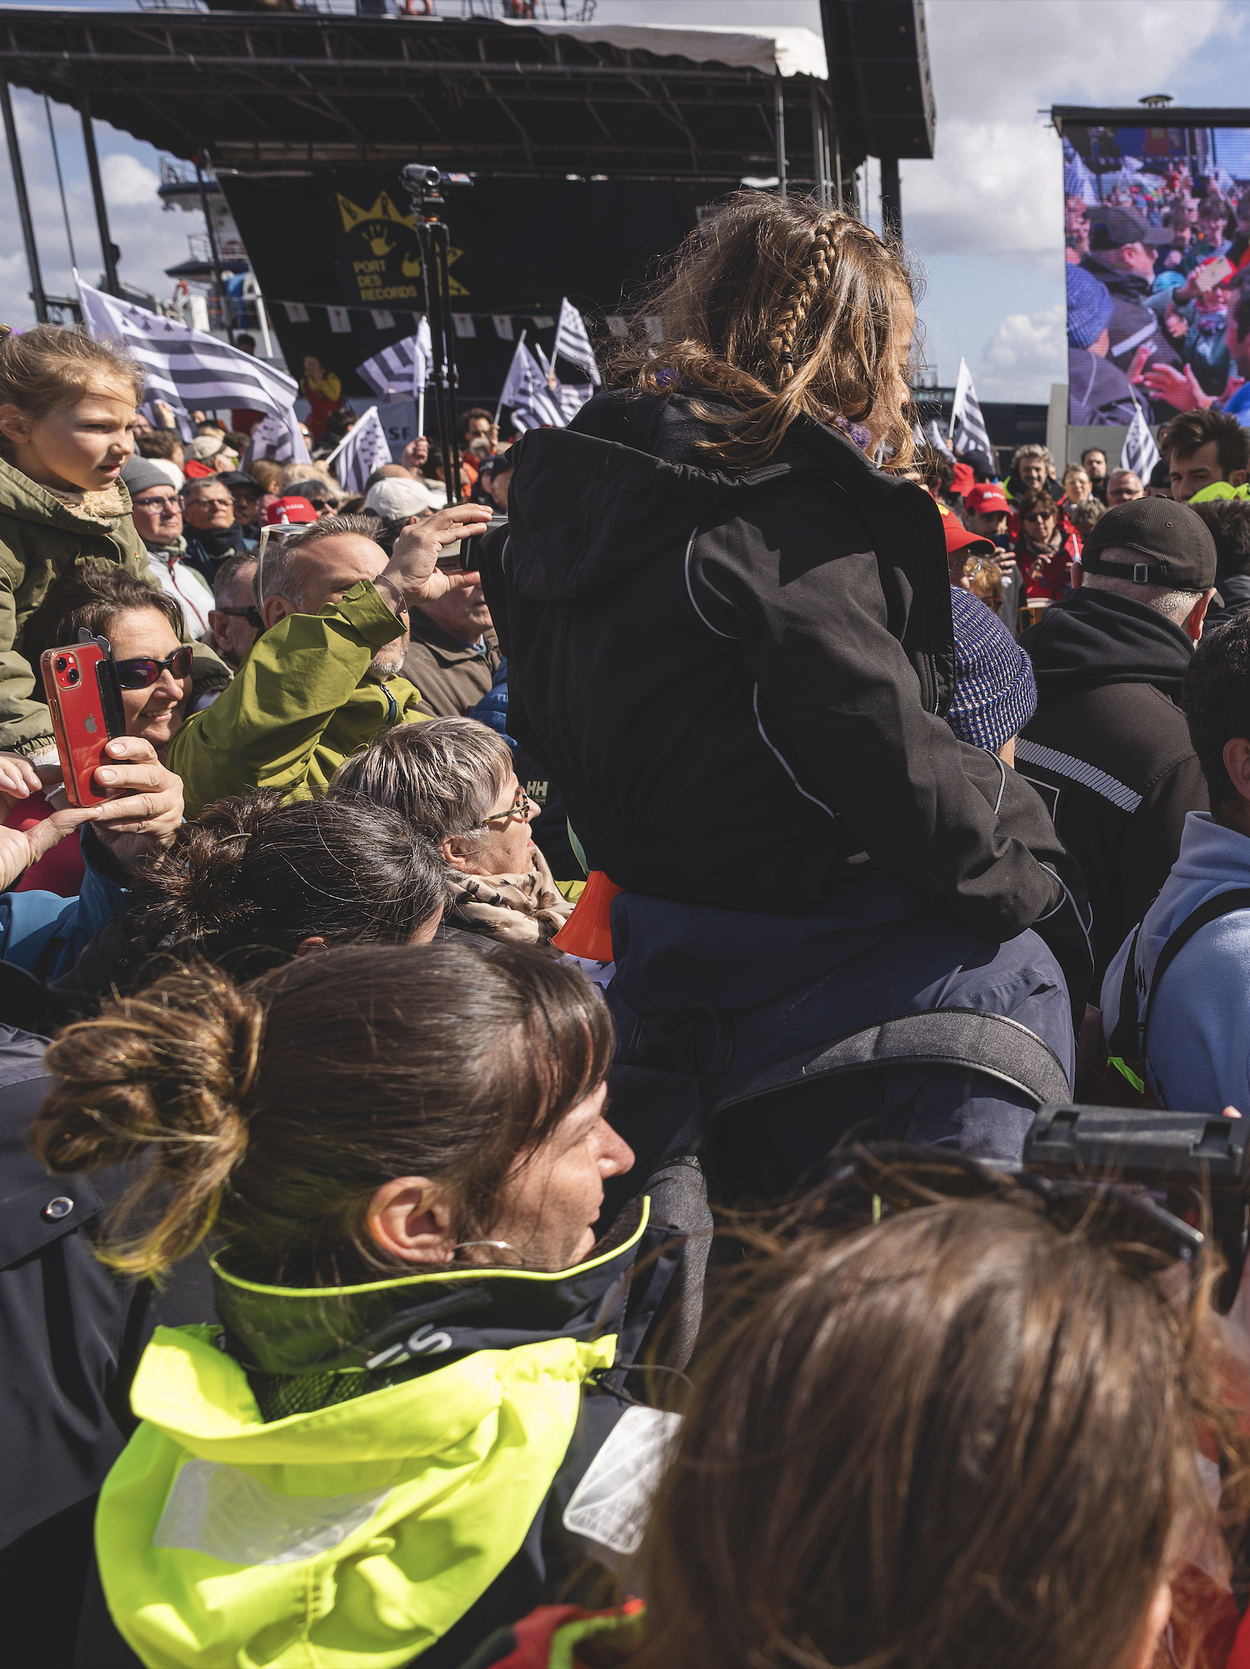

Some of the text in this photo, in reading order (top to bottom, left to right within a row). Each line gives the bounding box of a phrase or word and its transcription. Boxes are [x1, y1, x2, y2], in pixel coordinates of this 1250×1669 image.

[353, 260, 386, 274] PORT
[356, 274, 382, 288] DES
[360, 285, 418, 301] RECORDS
[387, 426, 410, 441] SF
[527, 781, 548, 796] HH
